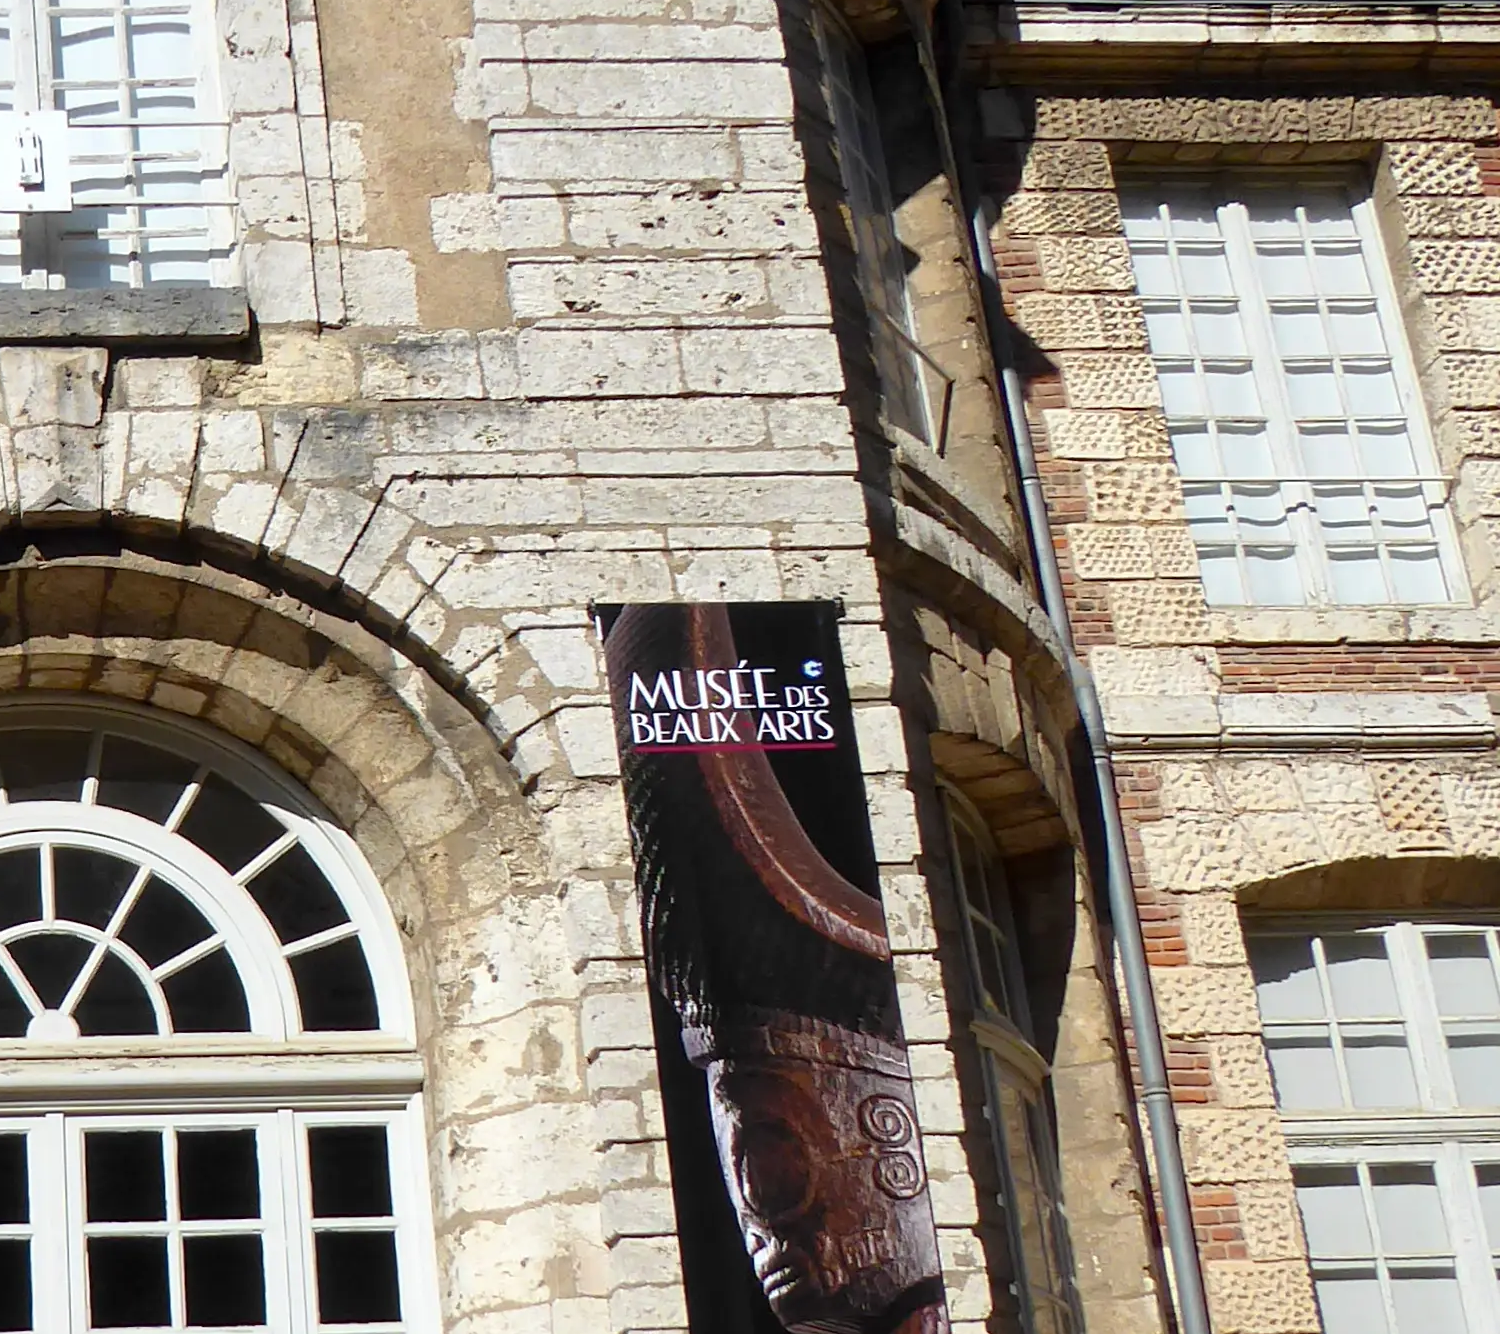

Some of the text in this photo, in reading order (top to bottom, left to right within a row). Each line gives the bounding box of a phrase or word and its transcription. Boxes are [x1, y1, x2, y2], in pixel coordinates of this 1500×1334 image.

[629, 660, 830, 710] MUSÉE DES
[631, 710, 835, 744] BEAUX ARTS
